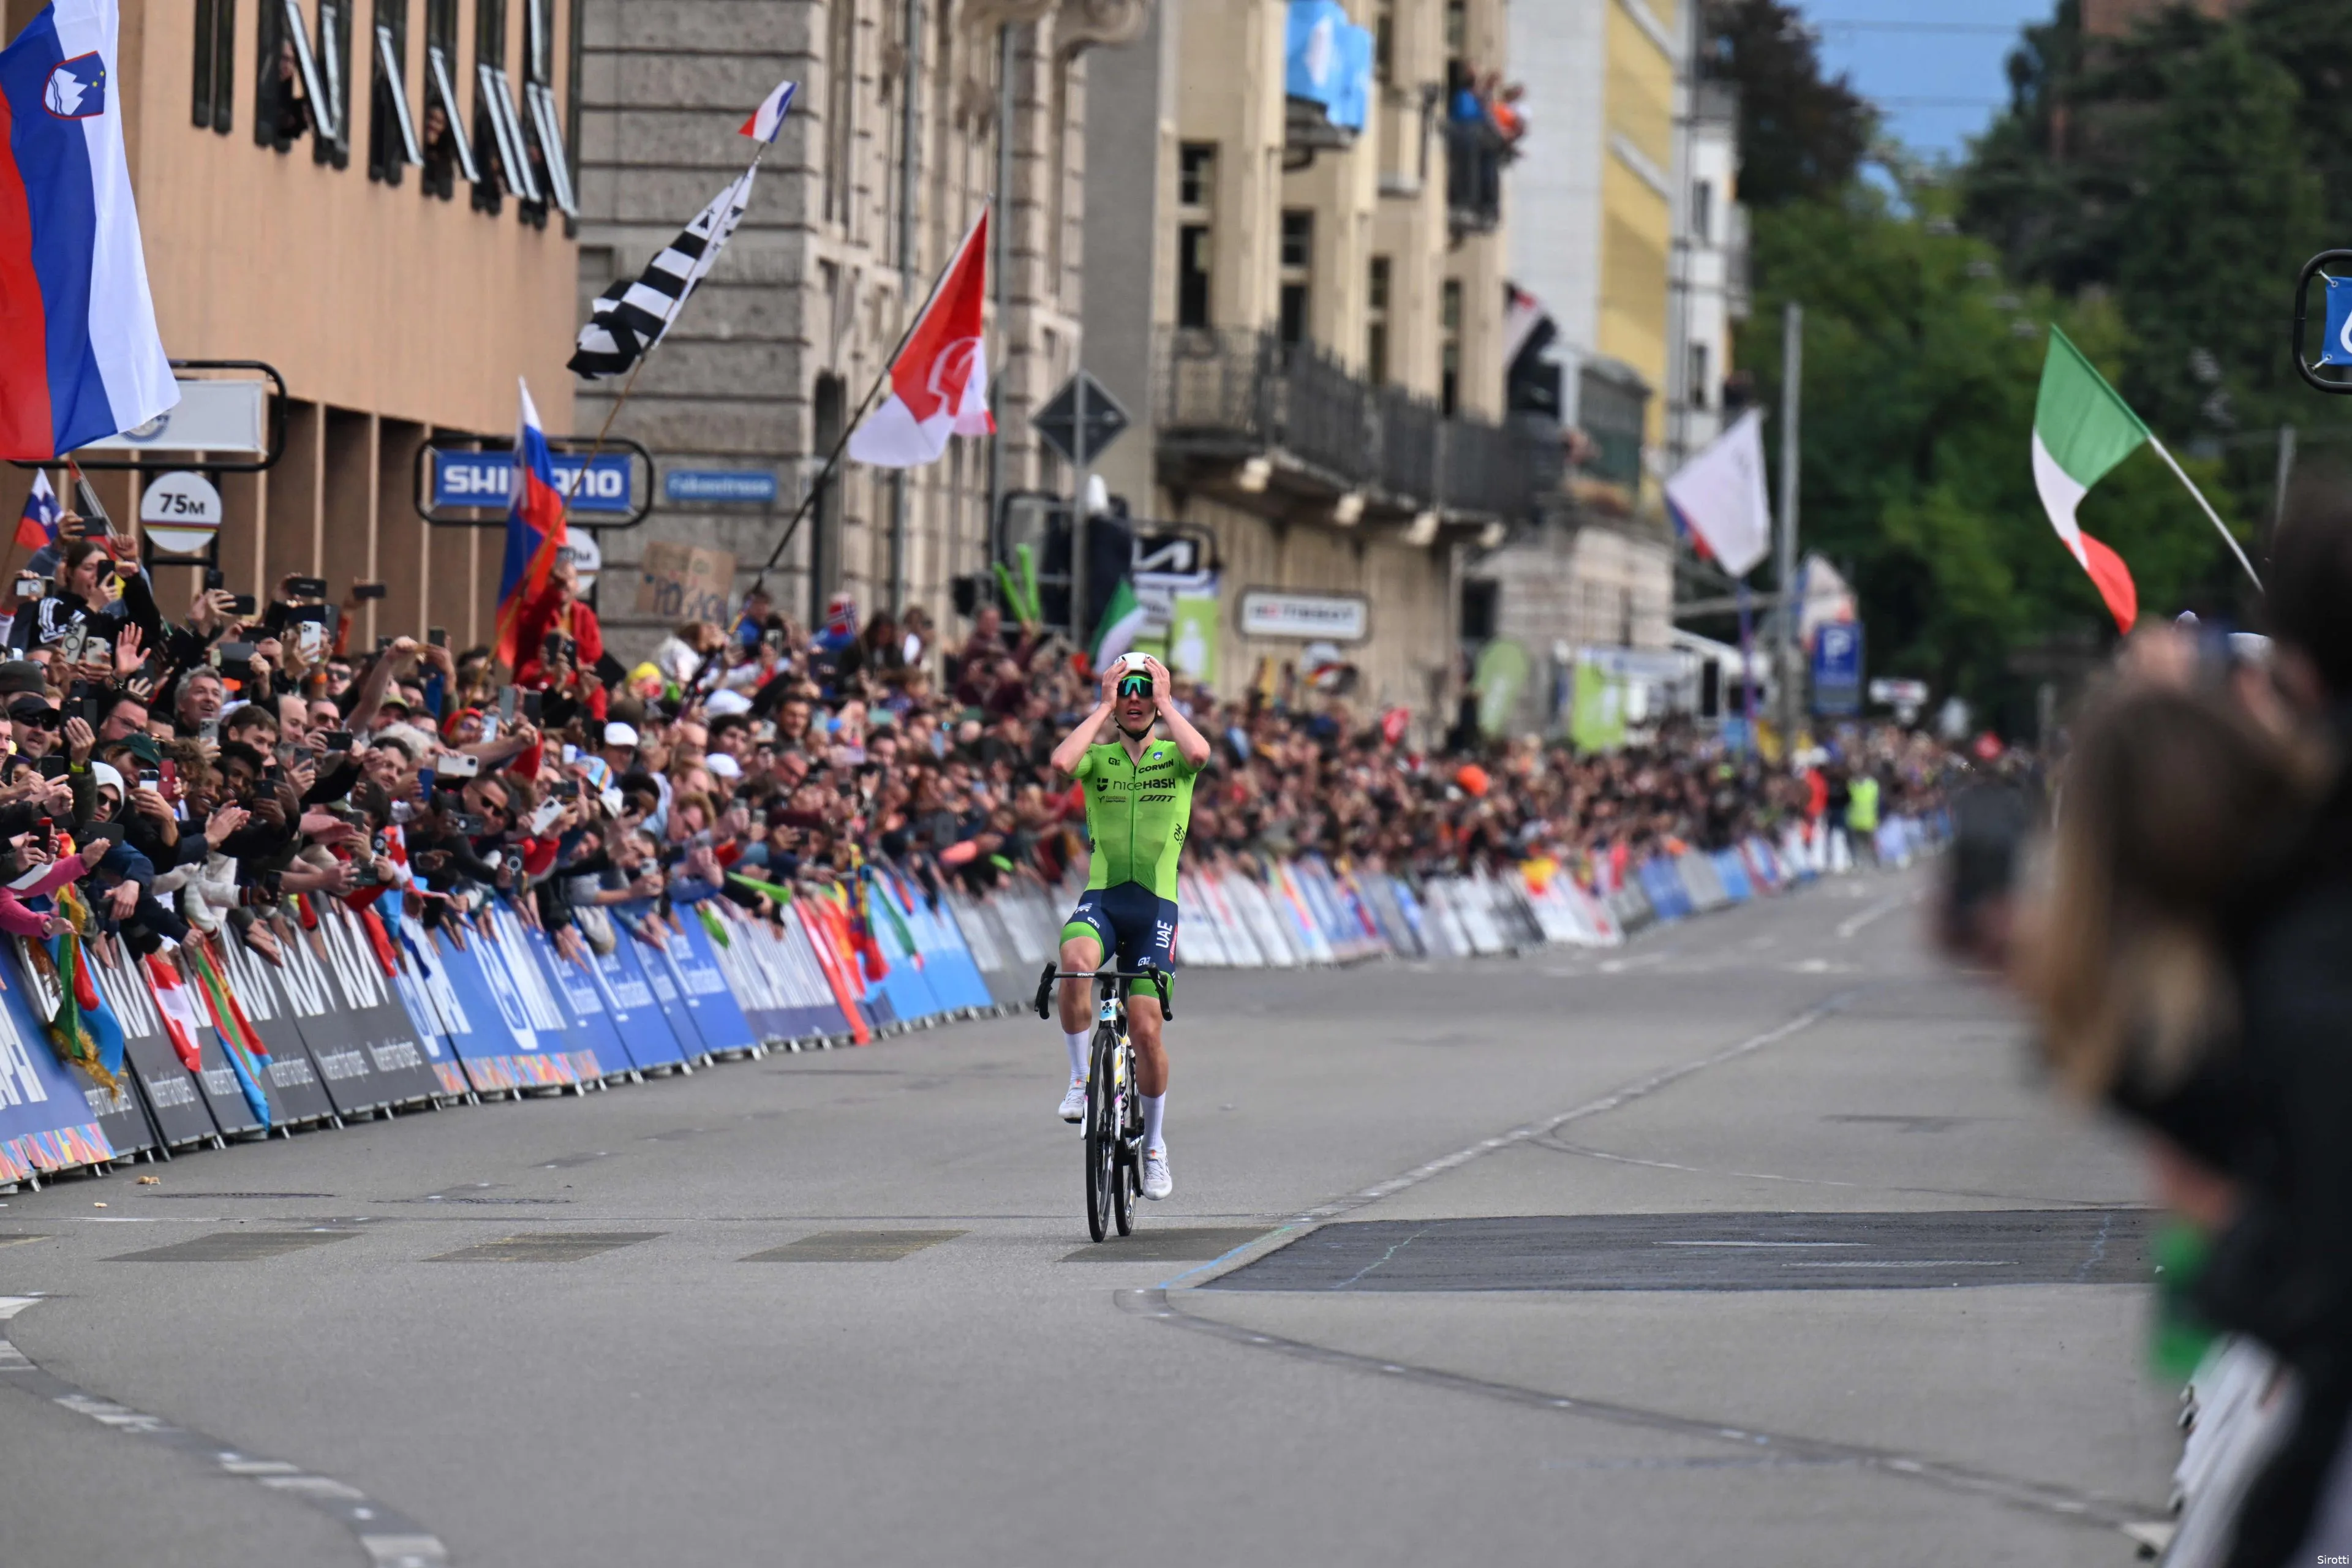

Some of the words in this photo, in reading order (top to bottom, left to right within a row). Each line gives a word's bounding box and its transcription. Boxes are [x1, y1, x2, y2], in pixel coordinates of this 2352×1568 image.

[443, 464, 624, 498] SHIANO
[159, 492, 206, 515] 75M
[1139, 758, 1174, 774] CORWIN
[1155, 919, 1173, 948] UAE
